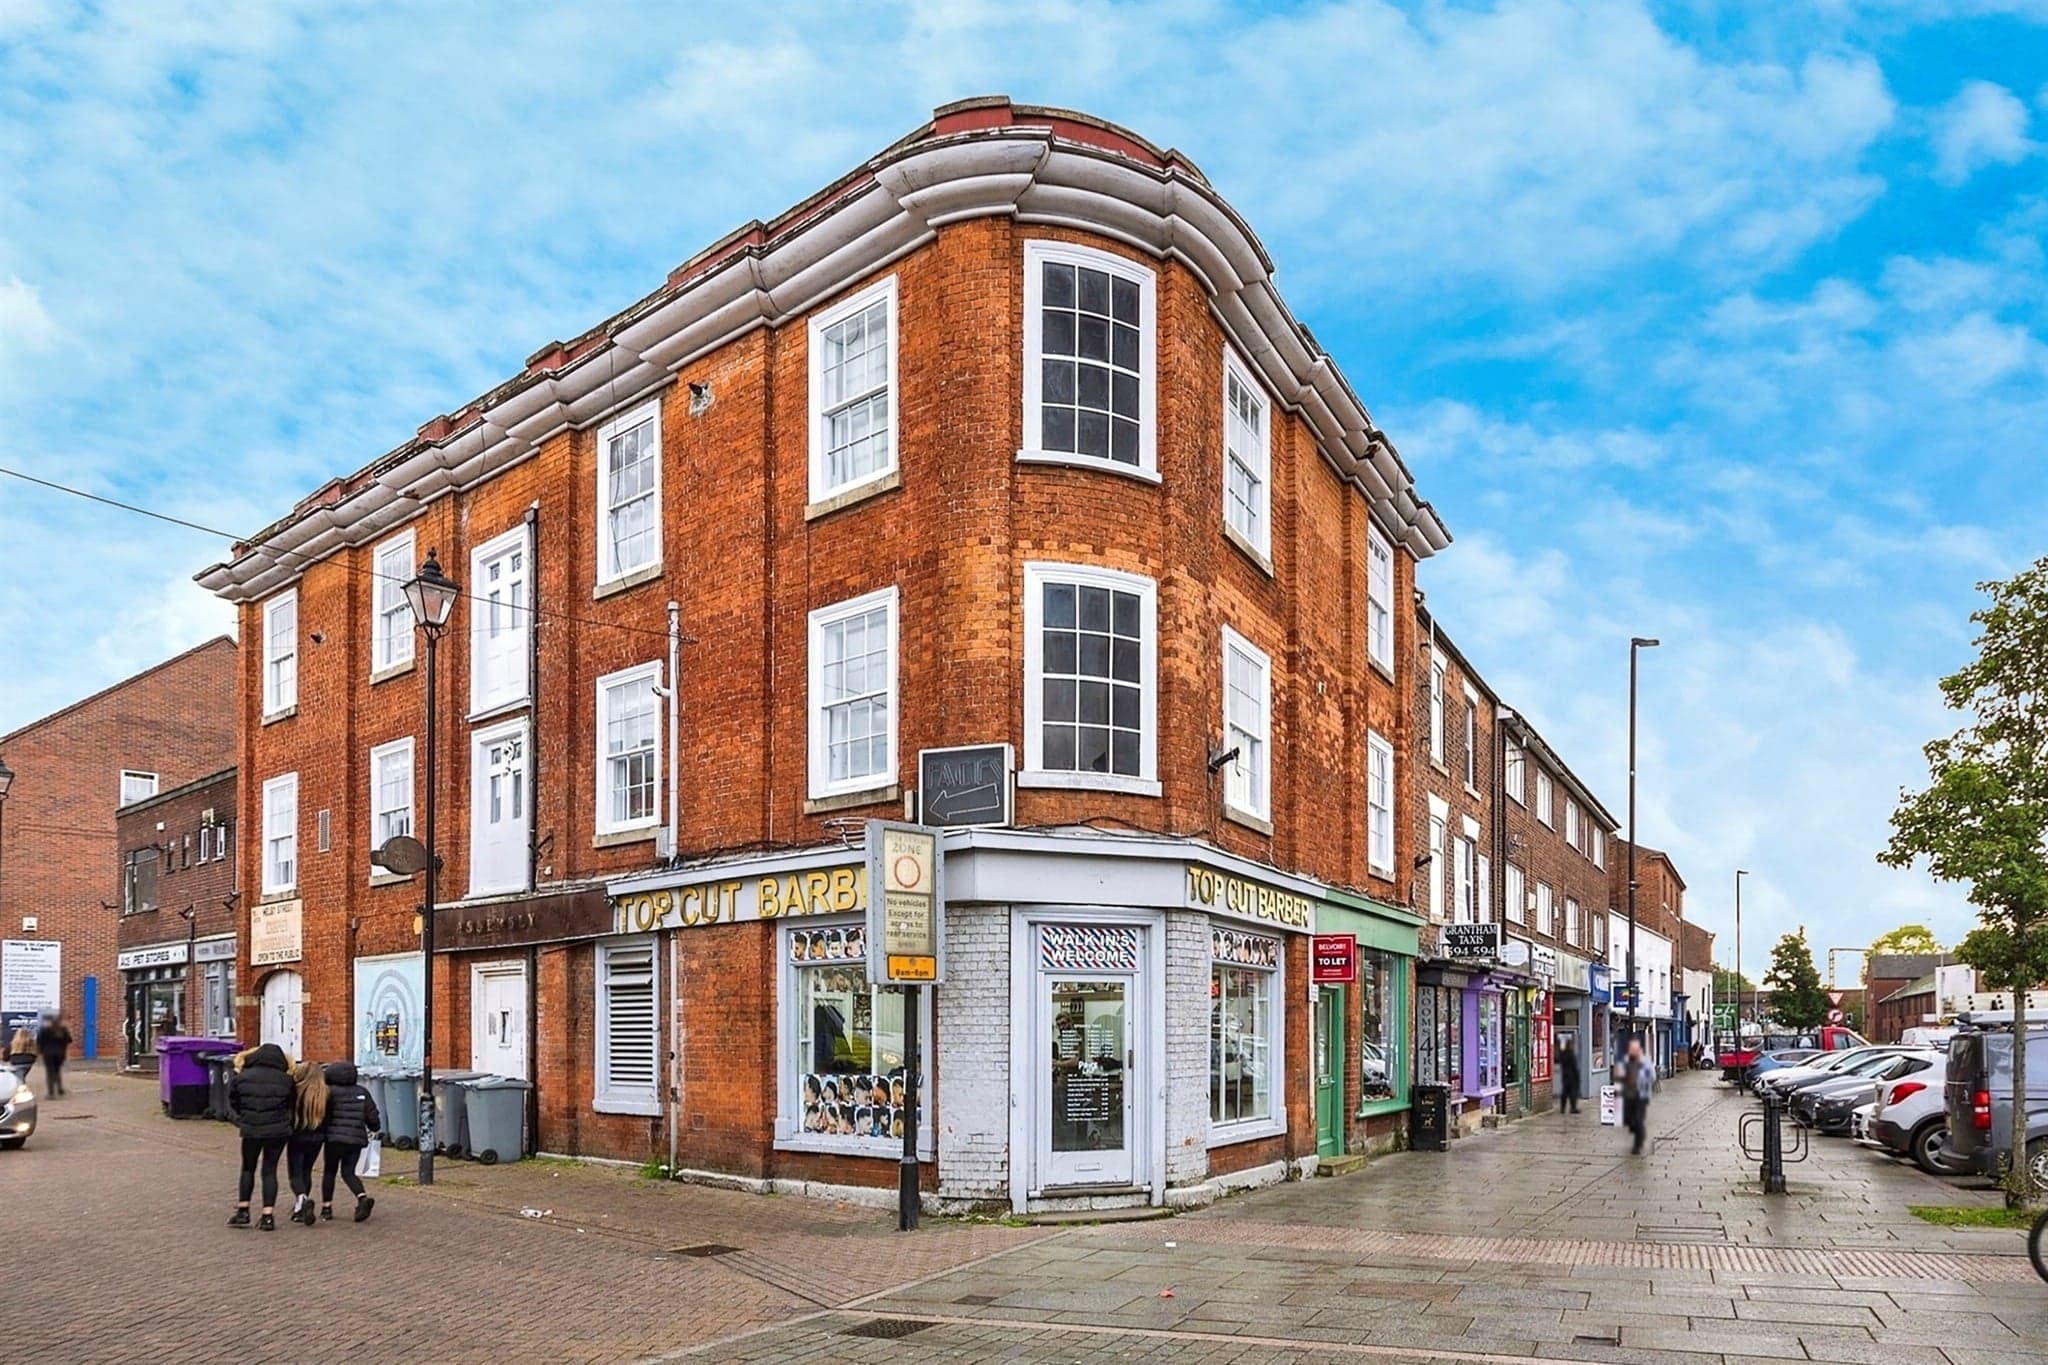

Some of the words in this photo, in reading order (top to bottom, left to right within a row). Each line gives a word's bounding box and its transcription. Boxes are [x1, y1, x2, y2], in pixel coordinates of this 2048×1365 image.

[892, 842, 922, 856] ZONE
[617, 890, 673, 934] TOP
[679, 881, 742, 927] CUT
[757, 868, 867, 919] BARB
[887, 897, 897, 906] No
[898, 898, 927, 908] vehicles
[1188, 866, 1225, 907] TOP
[1226, 878, 1257, 914] CUT
[1257, 887, 1310, 928] BARBER
[888, 908, 913, 920] Except
[914, 909, 924, 919] for
[915, 920, 924, 929] to
[1445, 924, 1497, 935] GRANTHAM
[901, 930, 927, 940] service
[1050, 934, 1095, 946] WALK
[1100, 935, 1130, 947] IN'S
[1458, 935, 1485, 945] TAXIS
[146, 950, 170, 963] STORES
[1051, 950, 1129, 962] WELCOME
[1473, 946, 1496, 957] 594
[1318, 957, 1331, 966] TO
[1331, 957, 1347, 966] LET
[1419, 1036, 1433, 1057] 4
